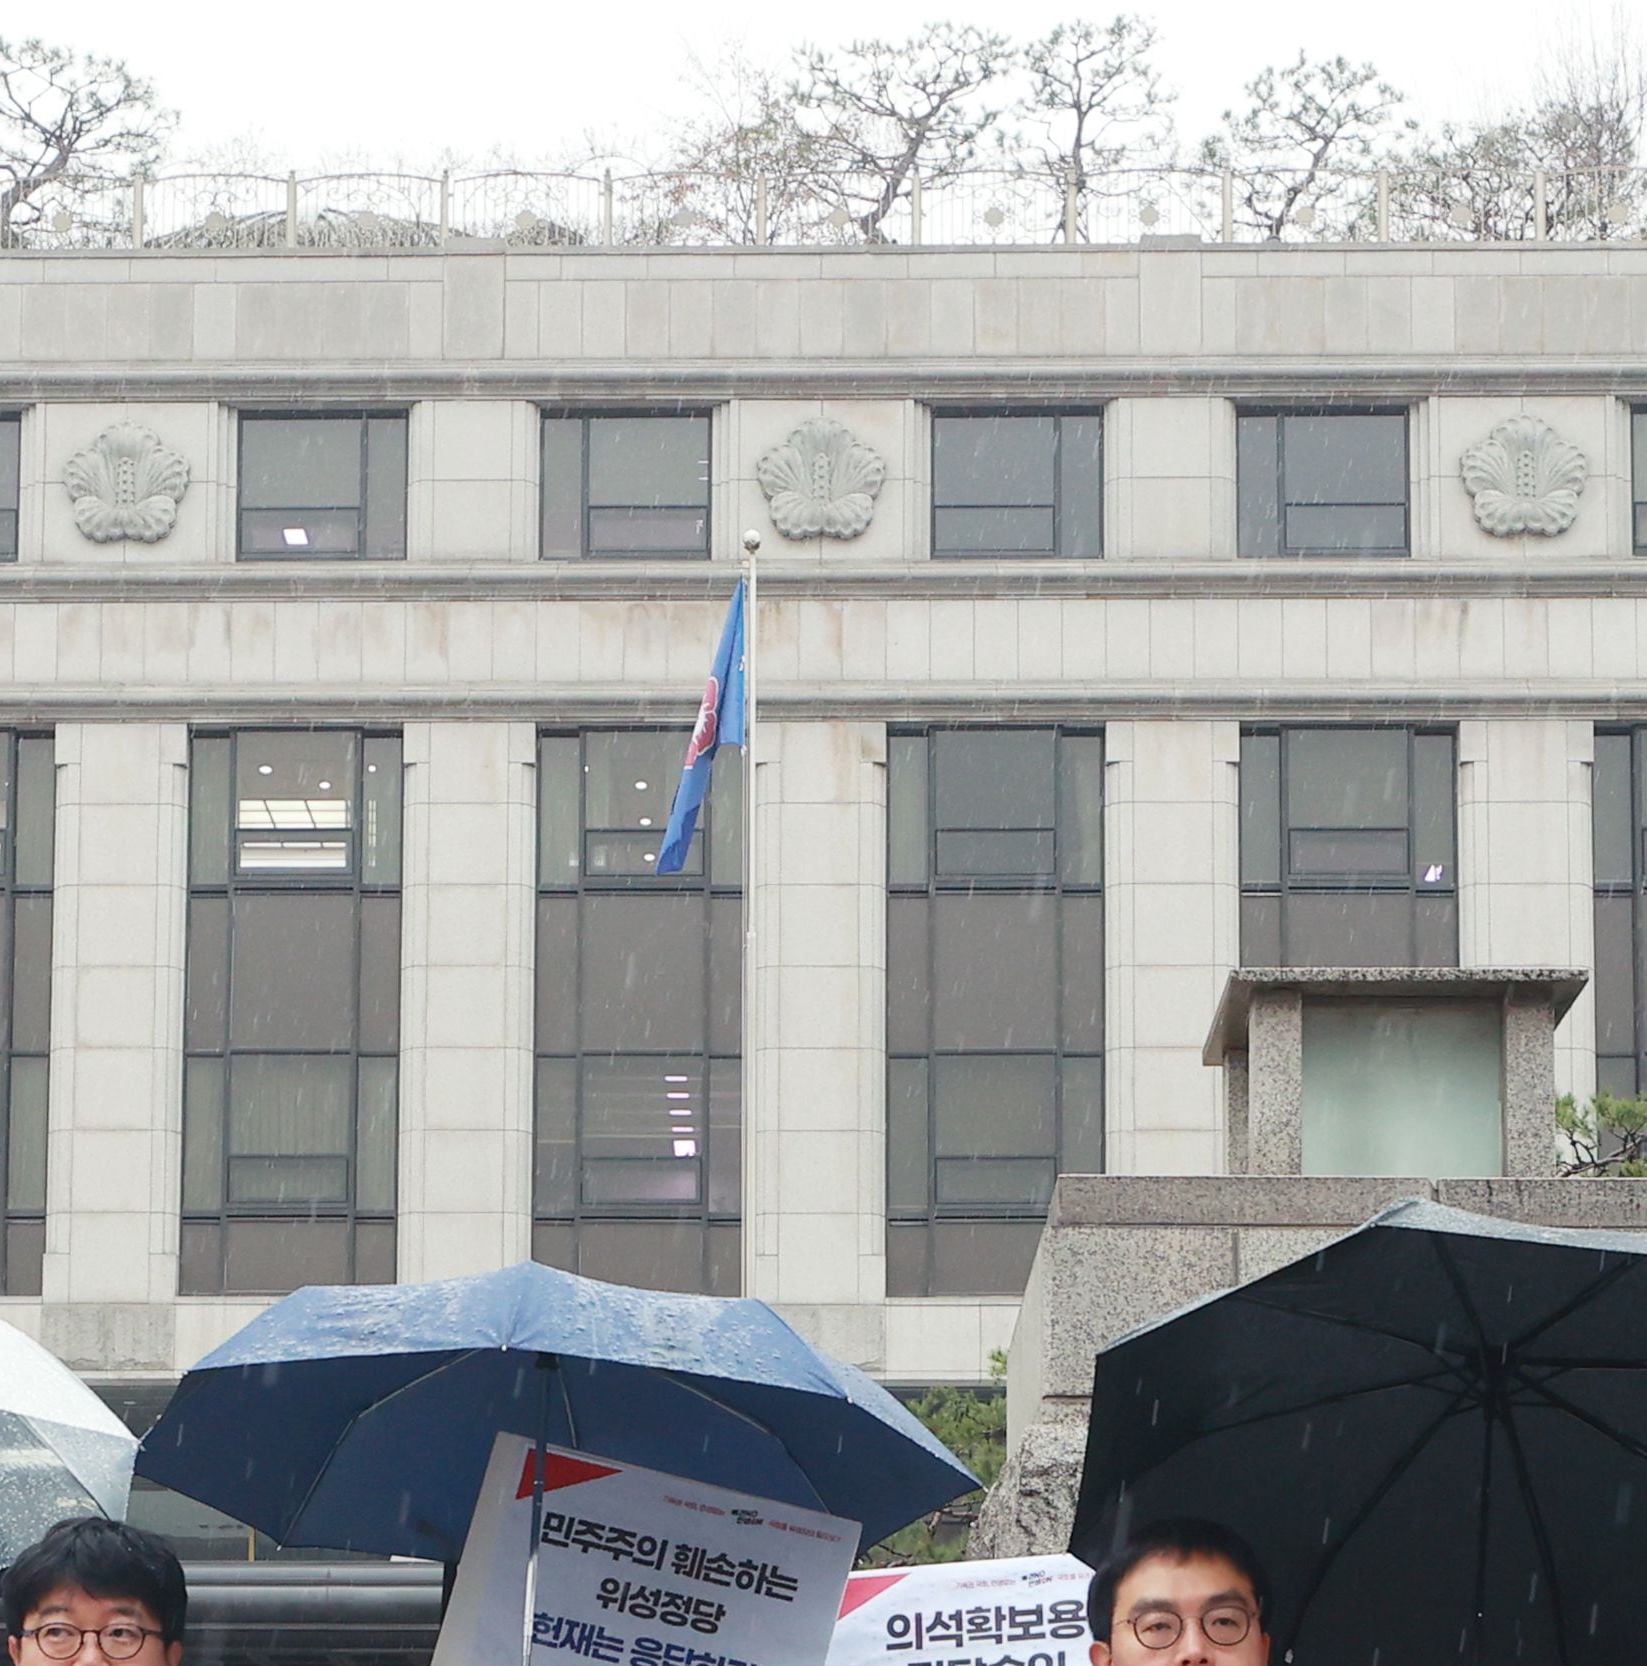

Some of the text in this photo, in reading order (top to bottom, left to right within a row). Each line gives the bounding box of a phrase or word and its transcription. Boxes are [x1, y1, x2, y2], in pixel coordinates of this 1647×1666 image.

[540, 1511, 798, 1602] 민주주의 훼손하는
[596, 1577, 726, 1634] 위성정당
[885, 1600, 1086, 1650] 의석확보용
[531, 1612, 625, 1664] 헌재는
